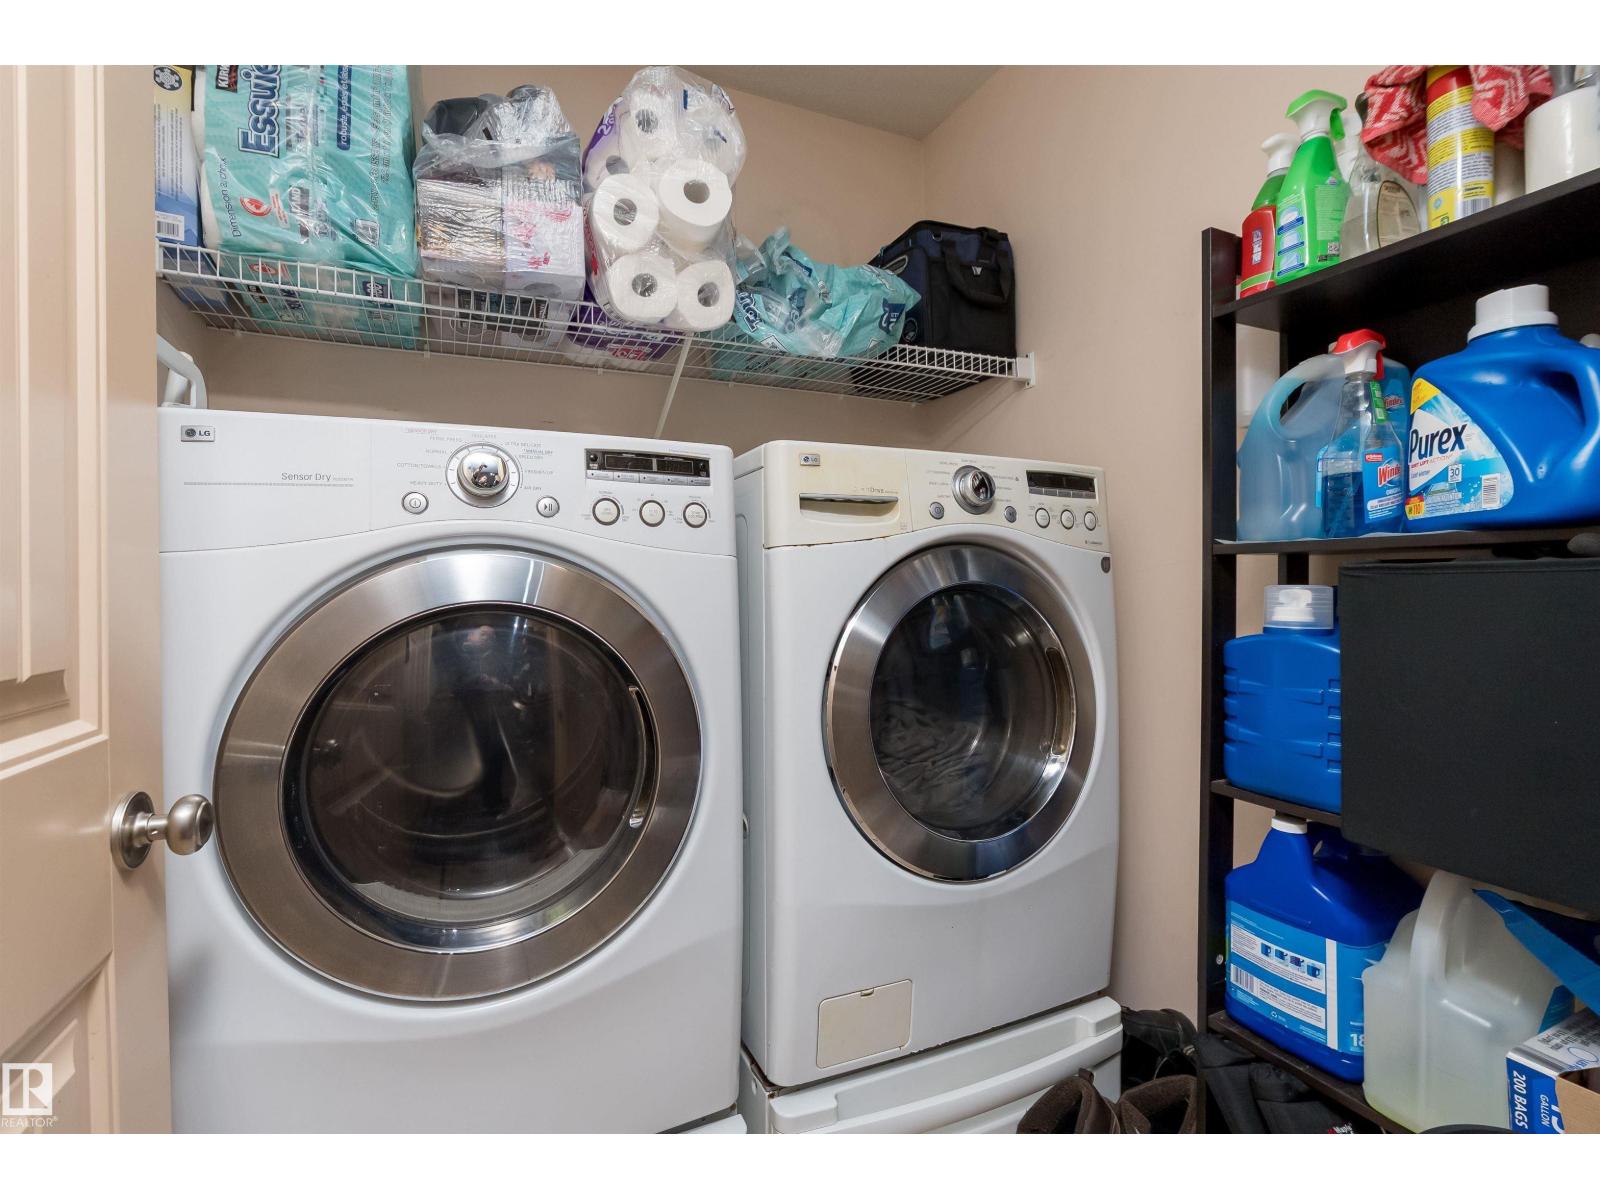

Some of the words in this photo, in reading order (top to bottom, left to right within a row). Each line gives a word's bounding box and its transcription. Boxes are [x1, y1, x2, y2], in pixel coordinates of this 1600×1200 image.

[199, 429, 211, 437] LG
[1409, 424, 1467, 463] Purex
[281, 472, 313, 481] Sensor
[315, 473, 331, 483] Dry
[1450, 467, 1460, 477] 30
[1513, 1070, 1527, 1094] 200
[1514, 1093, 1528, 1130] BAGS
[1540, 1094, 1551, 1127] GALLON
